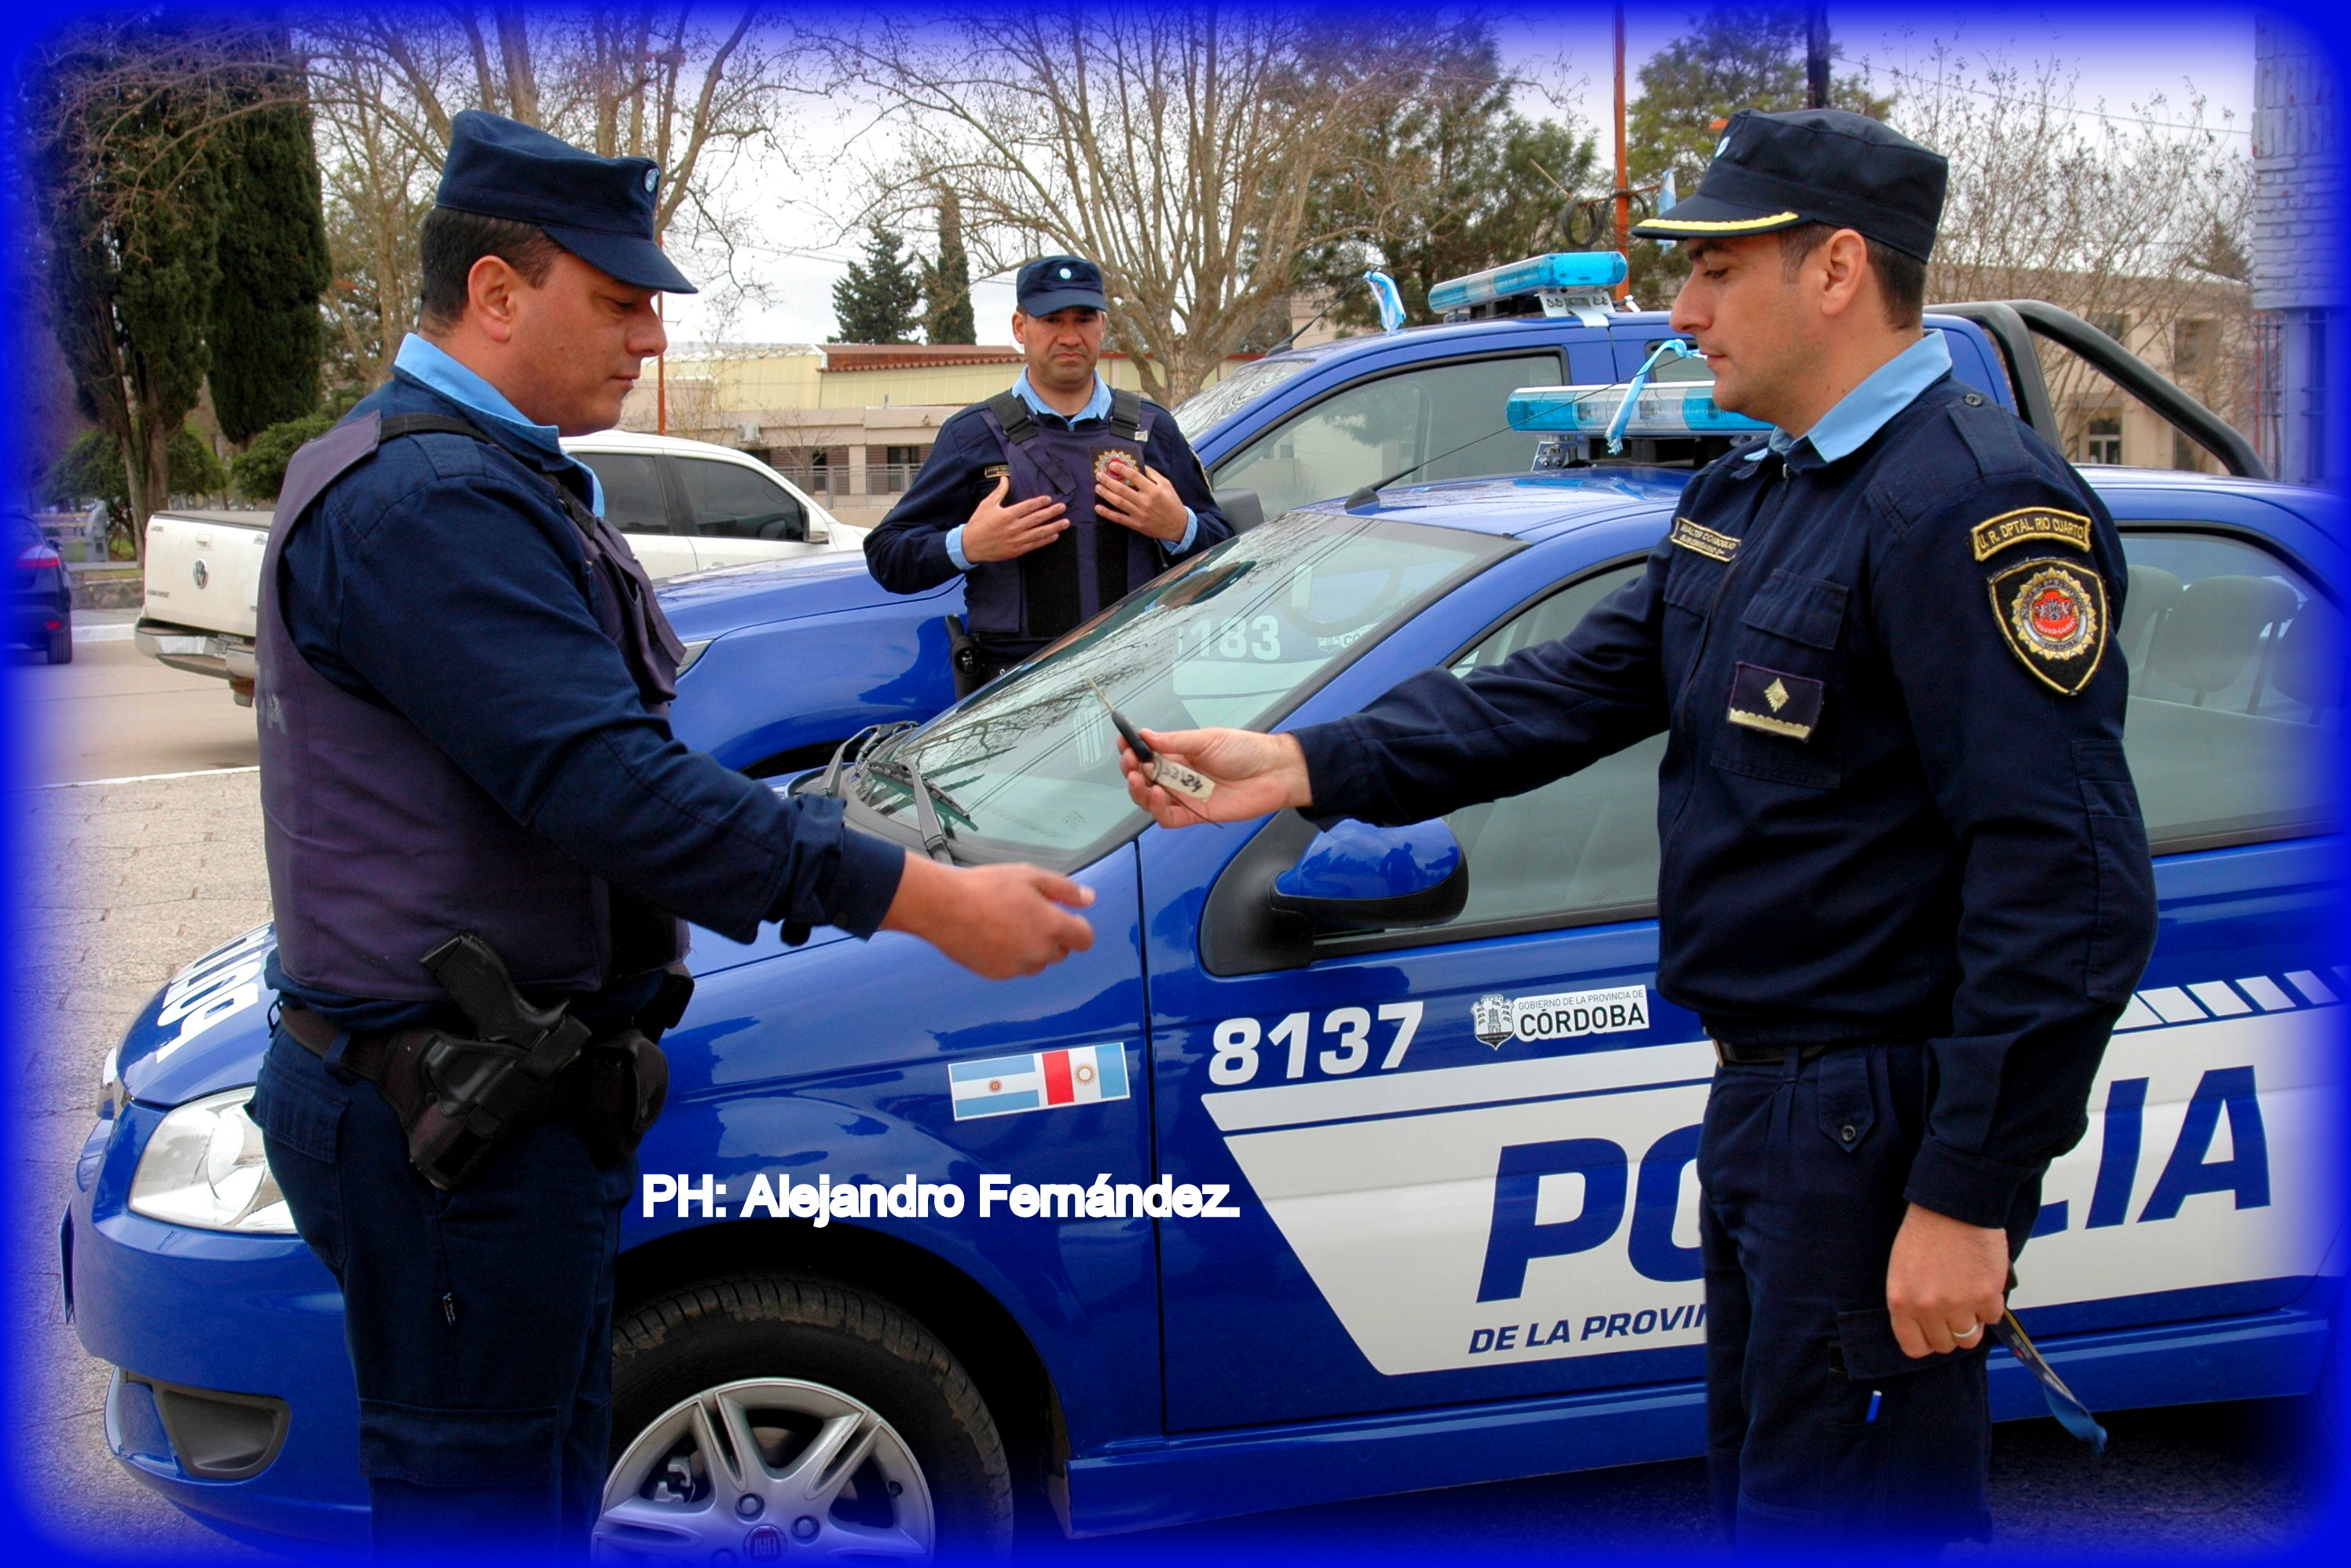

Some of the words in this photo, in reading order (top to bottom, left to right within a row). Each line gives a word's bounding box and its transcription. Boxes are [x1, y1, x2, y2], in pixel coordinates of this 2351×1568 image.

[2034, 517, 2051, 531] RIO
[2052, 518, 2084, 539] CUARTO
[1176, 614, 1282, 661] 183
[1518, 998, 1561, 1011] GOBIERNO
[1563, 996, 1575, 1006] DE
[1575, 995, 1586, 1005] LA
[1587, 991, 1632, 1003] PROVINCIA
[1633, 989, 1644, 998] DE
[1520, 1002, 1646, 1037] CÓRDOBA
[1209, 1000, 1424, 1086] 8137
[1468, 1324, 1520, 1354] DE
[1524, 1319, 1571, 1348] LA
